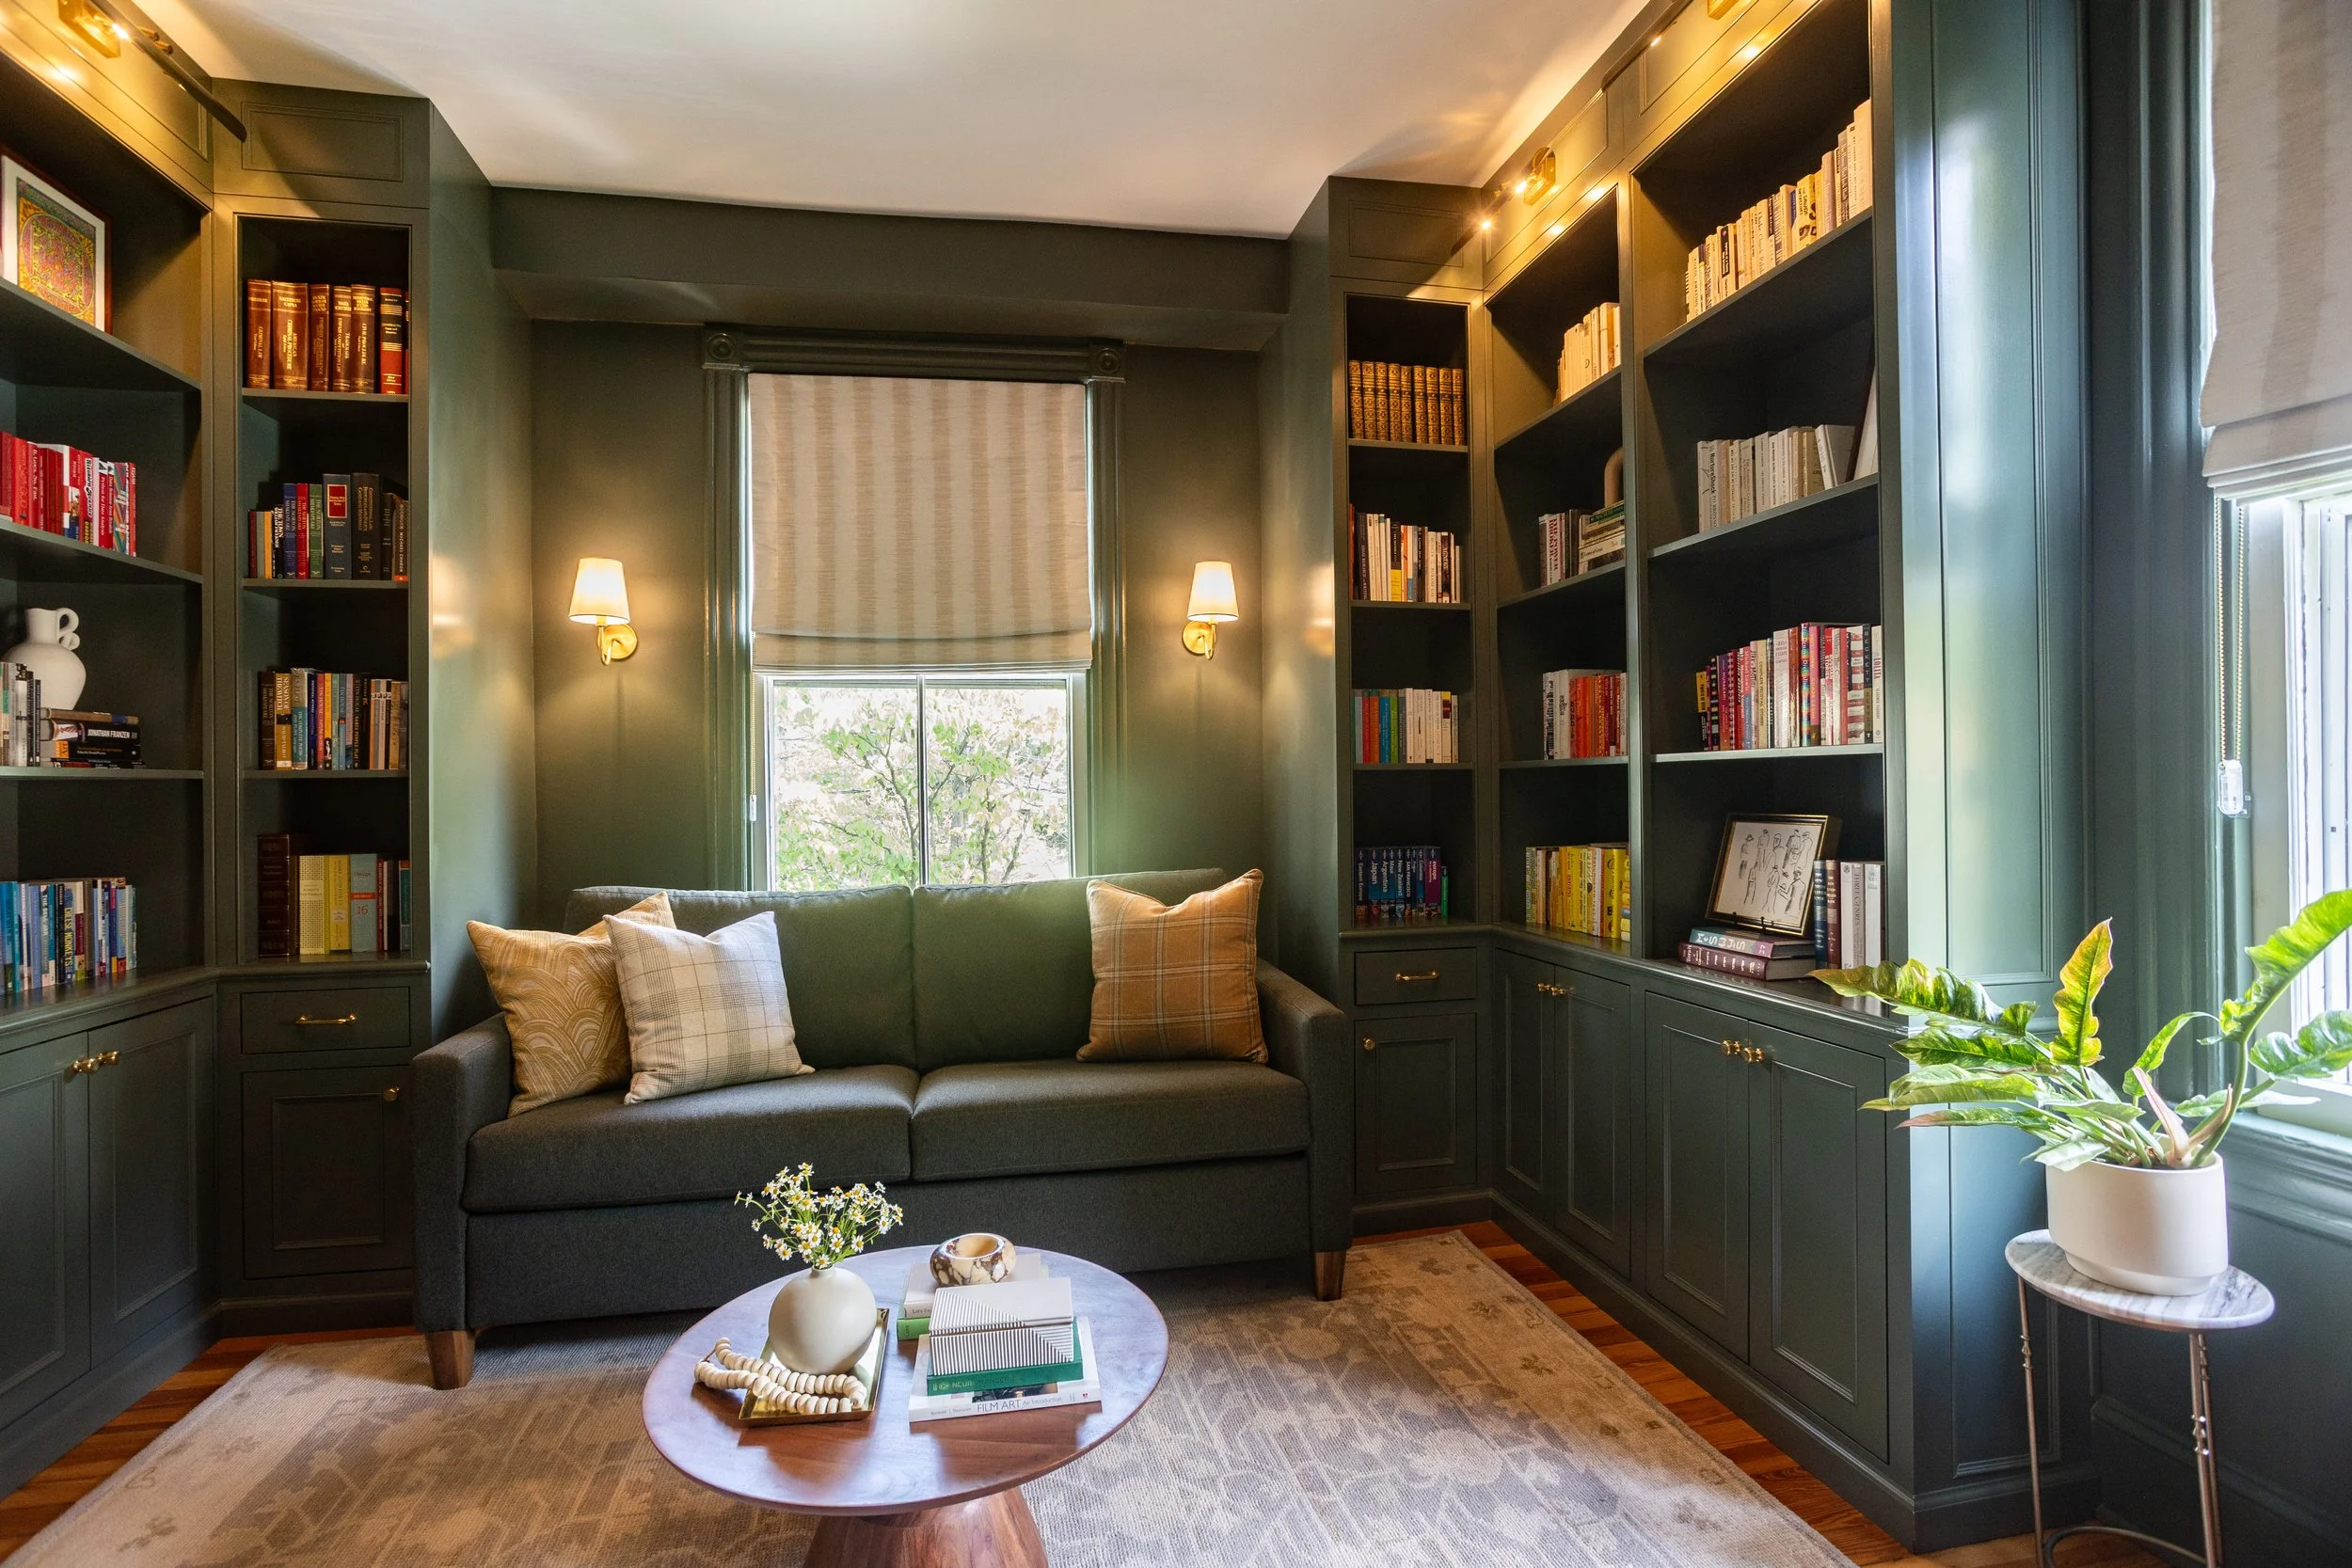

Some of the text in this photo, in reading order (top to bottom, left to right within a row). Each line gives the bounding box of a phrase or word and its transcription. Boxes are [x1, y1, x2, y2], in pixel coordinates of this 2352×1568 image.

[88, 729, 130, 739] JONATHAN FRANZEN
[358, 905, 369, 914] 16
[64, 907, 73, 966] CHEESE MONKEYS
[977, 1403, 998, 1413] FILM
[1001, 1400, 1020, 1410] ART
[1032, 1397, 1062, 1405] Introduction
